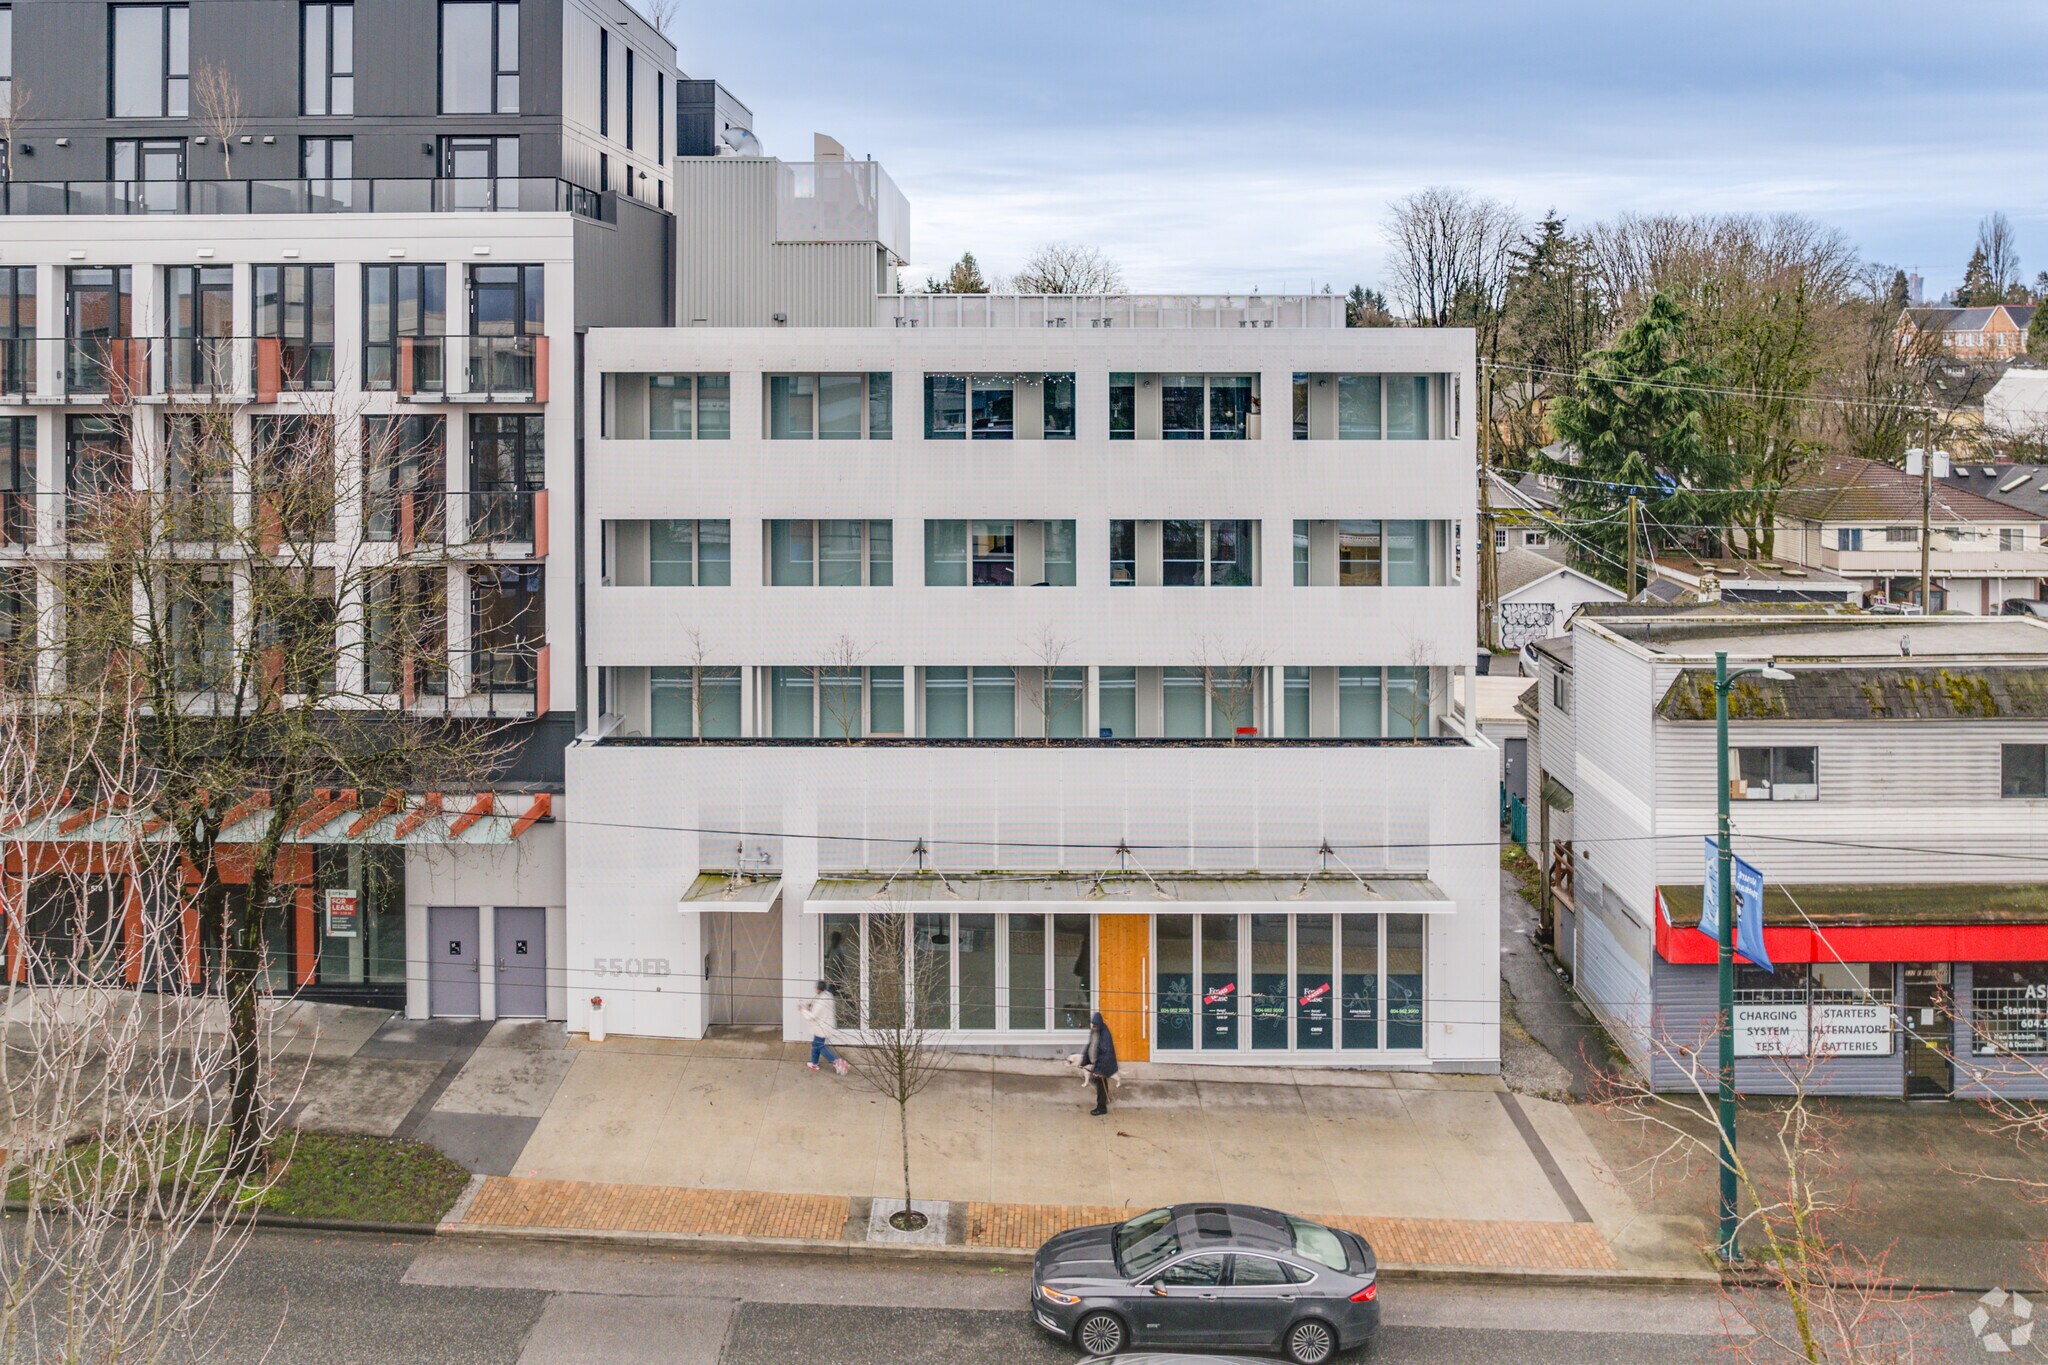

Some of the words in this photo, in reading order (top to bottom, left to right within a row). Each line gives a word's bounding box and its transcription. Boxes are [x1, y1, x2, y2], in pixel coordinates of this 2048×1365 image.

[2025, 984, 2048, 999] AS
[1824, 1008, 1877, 1018] STARTERS
[2002, 1006, 2040, 1015] Starters
[1739, 1011, 1797, 1020] CHARGING
[2021, 1019, 2048, 1028] 604.5
[1747, 1027, 1790, 1036] SYSTEM
[1755, 1042, 1781, 1051] TEST
[1821, 1041, 1878, 1051] BATTERIES
